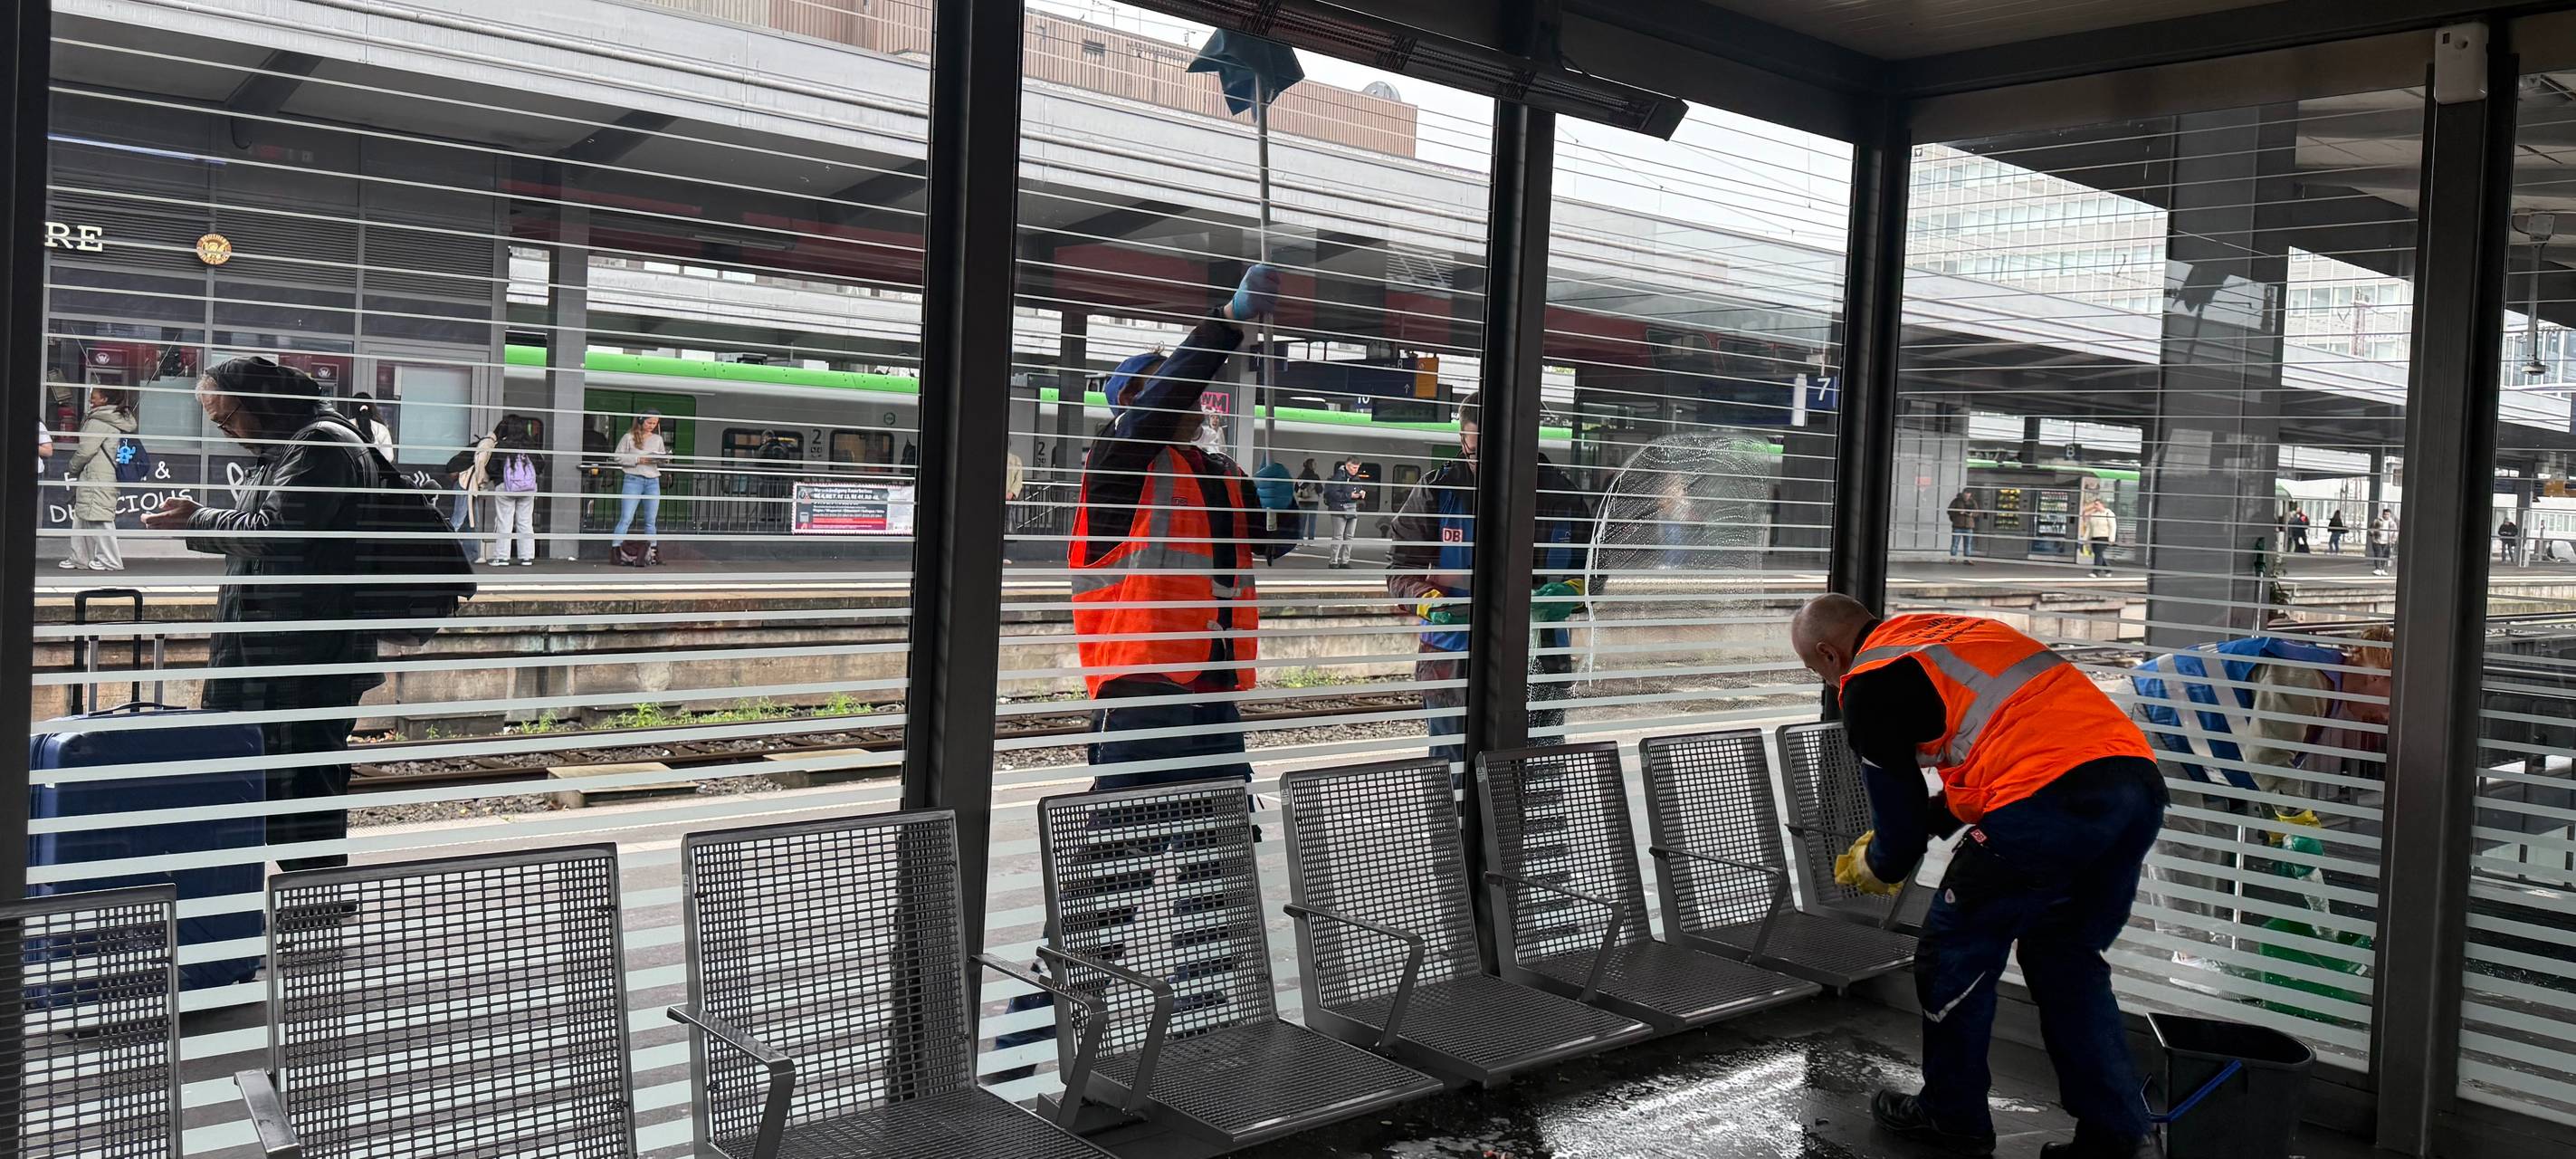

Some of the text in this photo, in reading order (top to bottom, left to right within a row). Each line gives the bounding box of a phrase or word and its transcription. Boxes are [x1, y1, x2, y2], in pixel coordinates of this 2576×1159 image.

[1818, 378, 1831, 400] 7
[813, 429, 822, 445] 2
[1037, 441, 1045, 455] 2
[2066, 445, 2075, 457] B
[155, 461, 171, 479] &
[1444, 530, 1461, 541] DB
